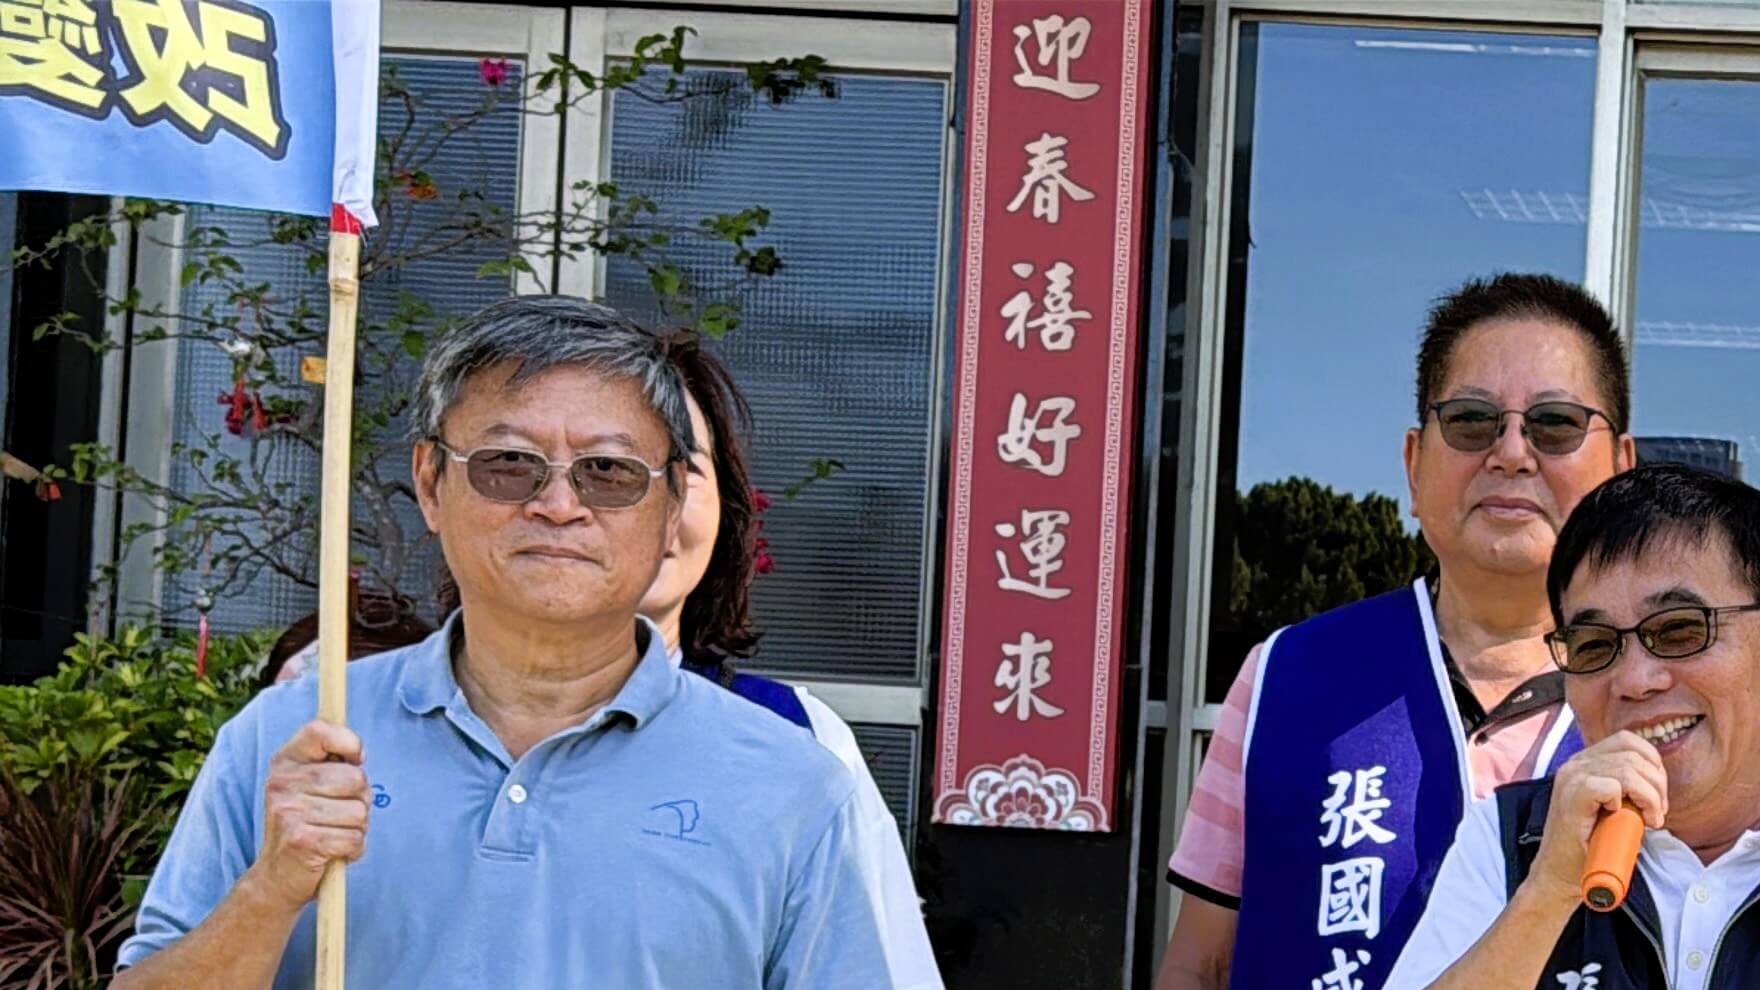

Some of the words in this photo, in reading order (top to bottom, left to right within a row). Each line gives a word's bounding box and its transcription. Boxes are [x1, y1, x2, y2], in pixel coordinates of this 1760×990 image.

[992, 14, 1101, 722] 迎春禧好運來
